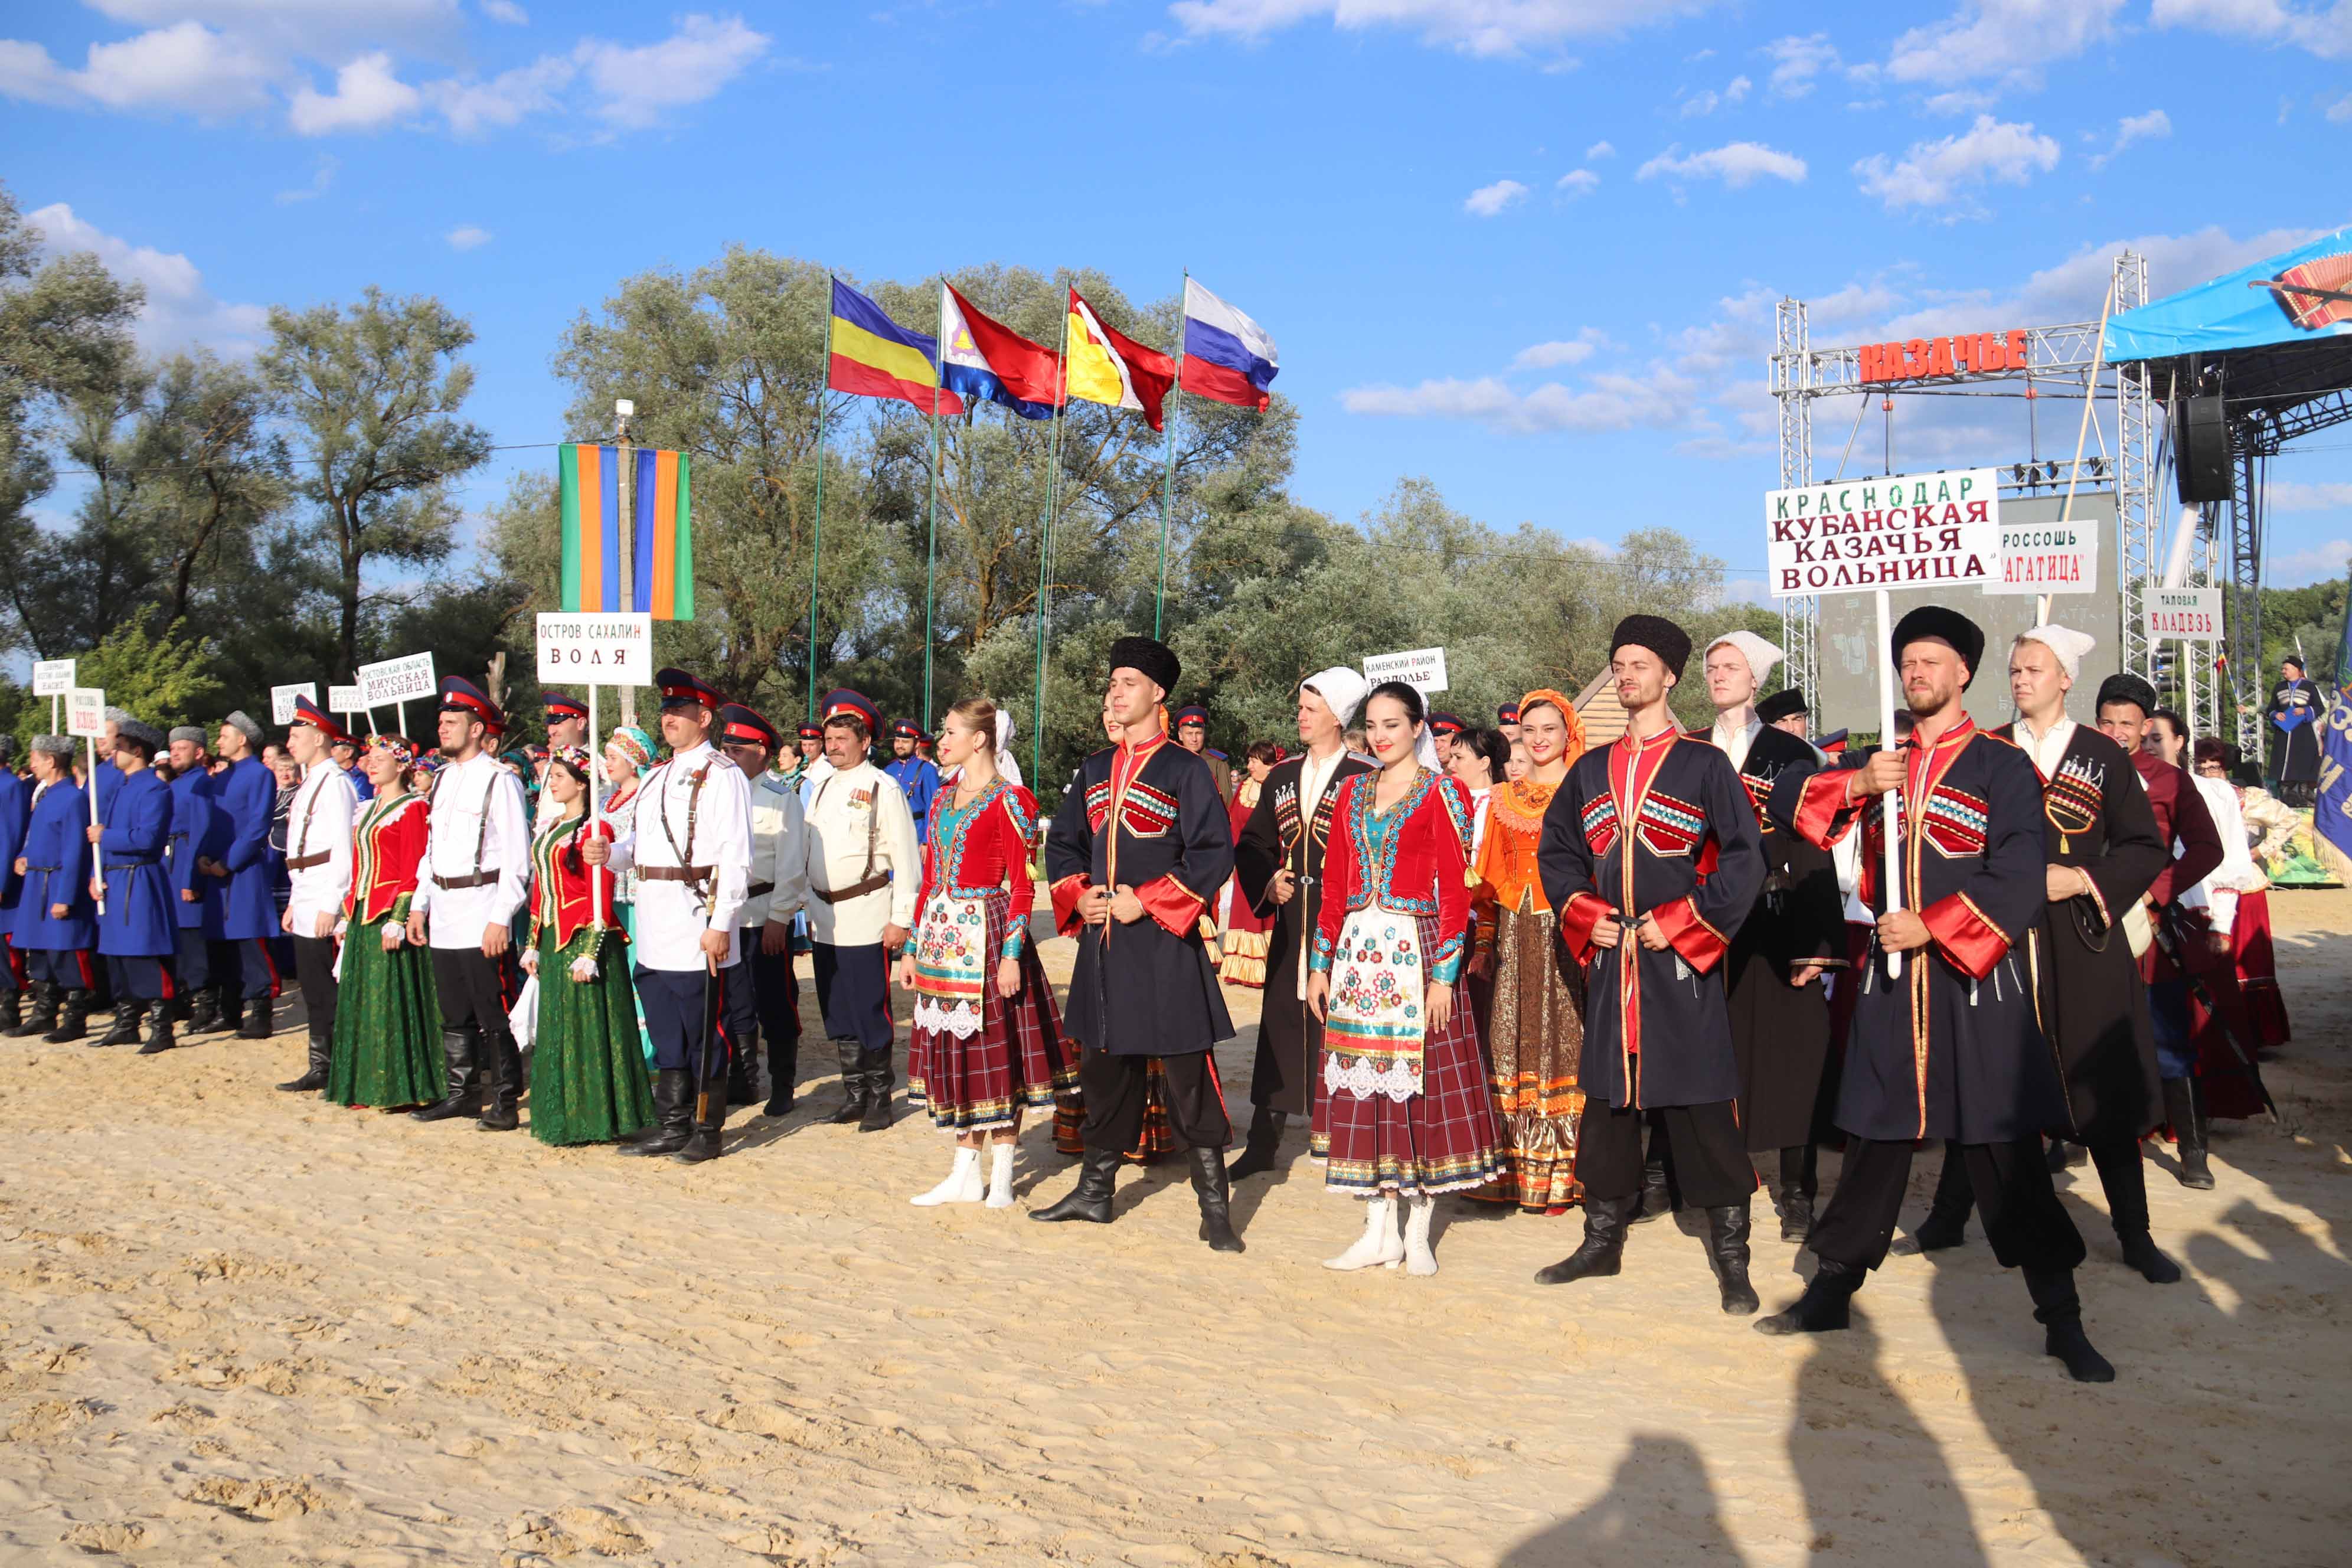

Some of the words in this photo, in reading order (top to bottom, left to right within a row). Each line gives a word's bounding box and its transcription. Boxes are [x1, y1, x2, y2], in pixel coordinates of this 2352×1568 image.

[1860, 329, 2027, 383] КАЗАЧЬЕ
[1776, 477, 1973, 519] КРАСНОДАР
[1794, 527, 1962, 563] КАЗАЧЬЯ
[2003, 530, 2076, 548] РОССОШЬ
[541, 624, 581, 638] ОСТРОВ
[589, 624, 641, 639] САХАЛИН
[2151, 612, 2211, 633] КЛАДЕЗЬ
[1366, 657, 1409, 672] КАМЕНСКИЙ
[1412, 655, 1436, 667] РАЙОН
[367, 669, 429, 691] МИУССКАЯ
[367, 680, 430, 701] ВОЛЬНИЦА
